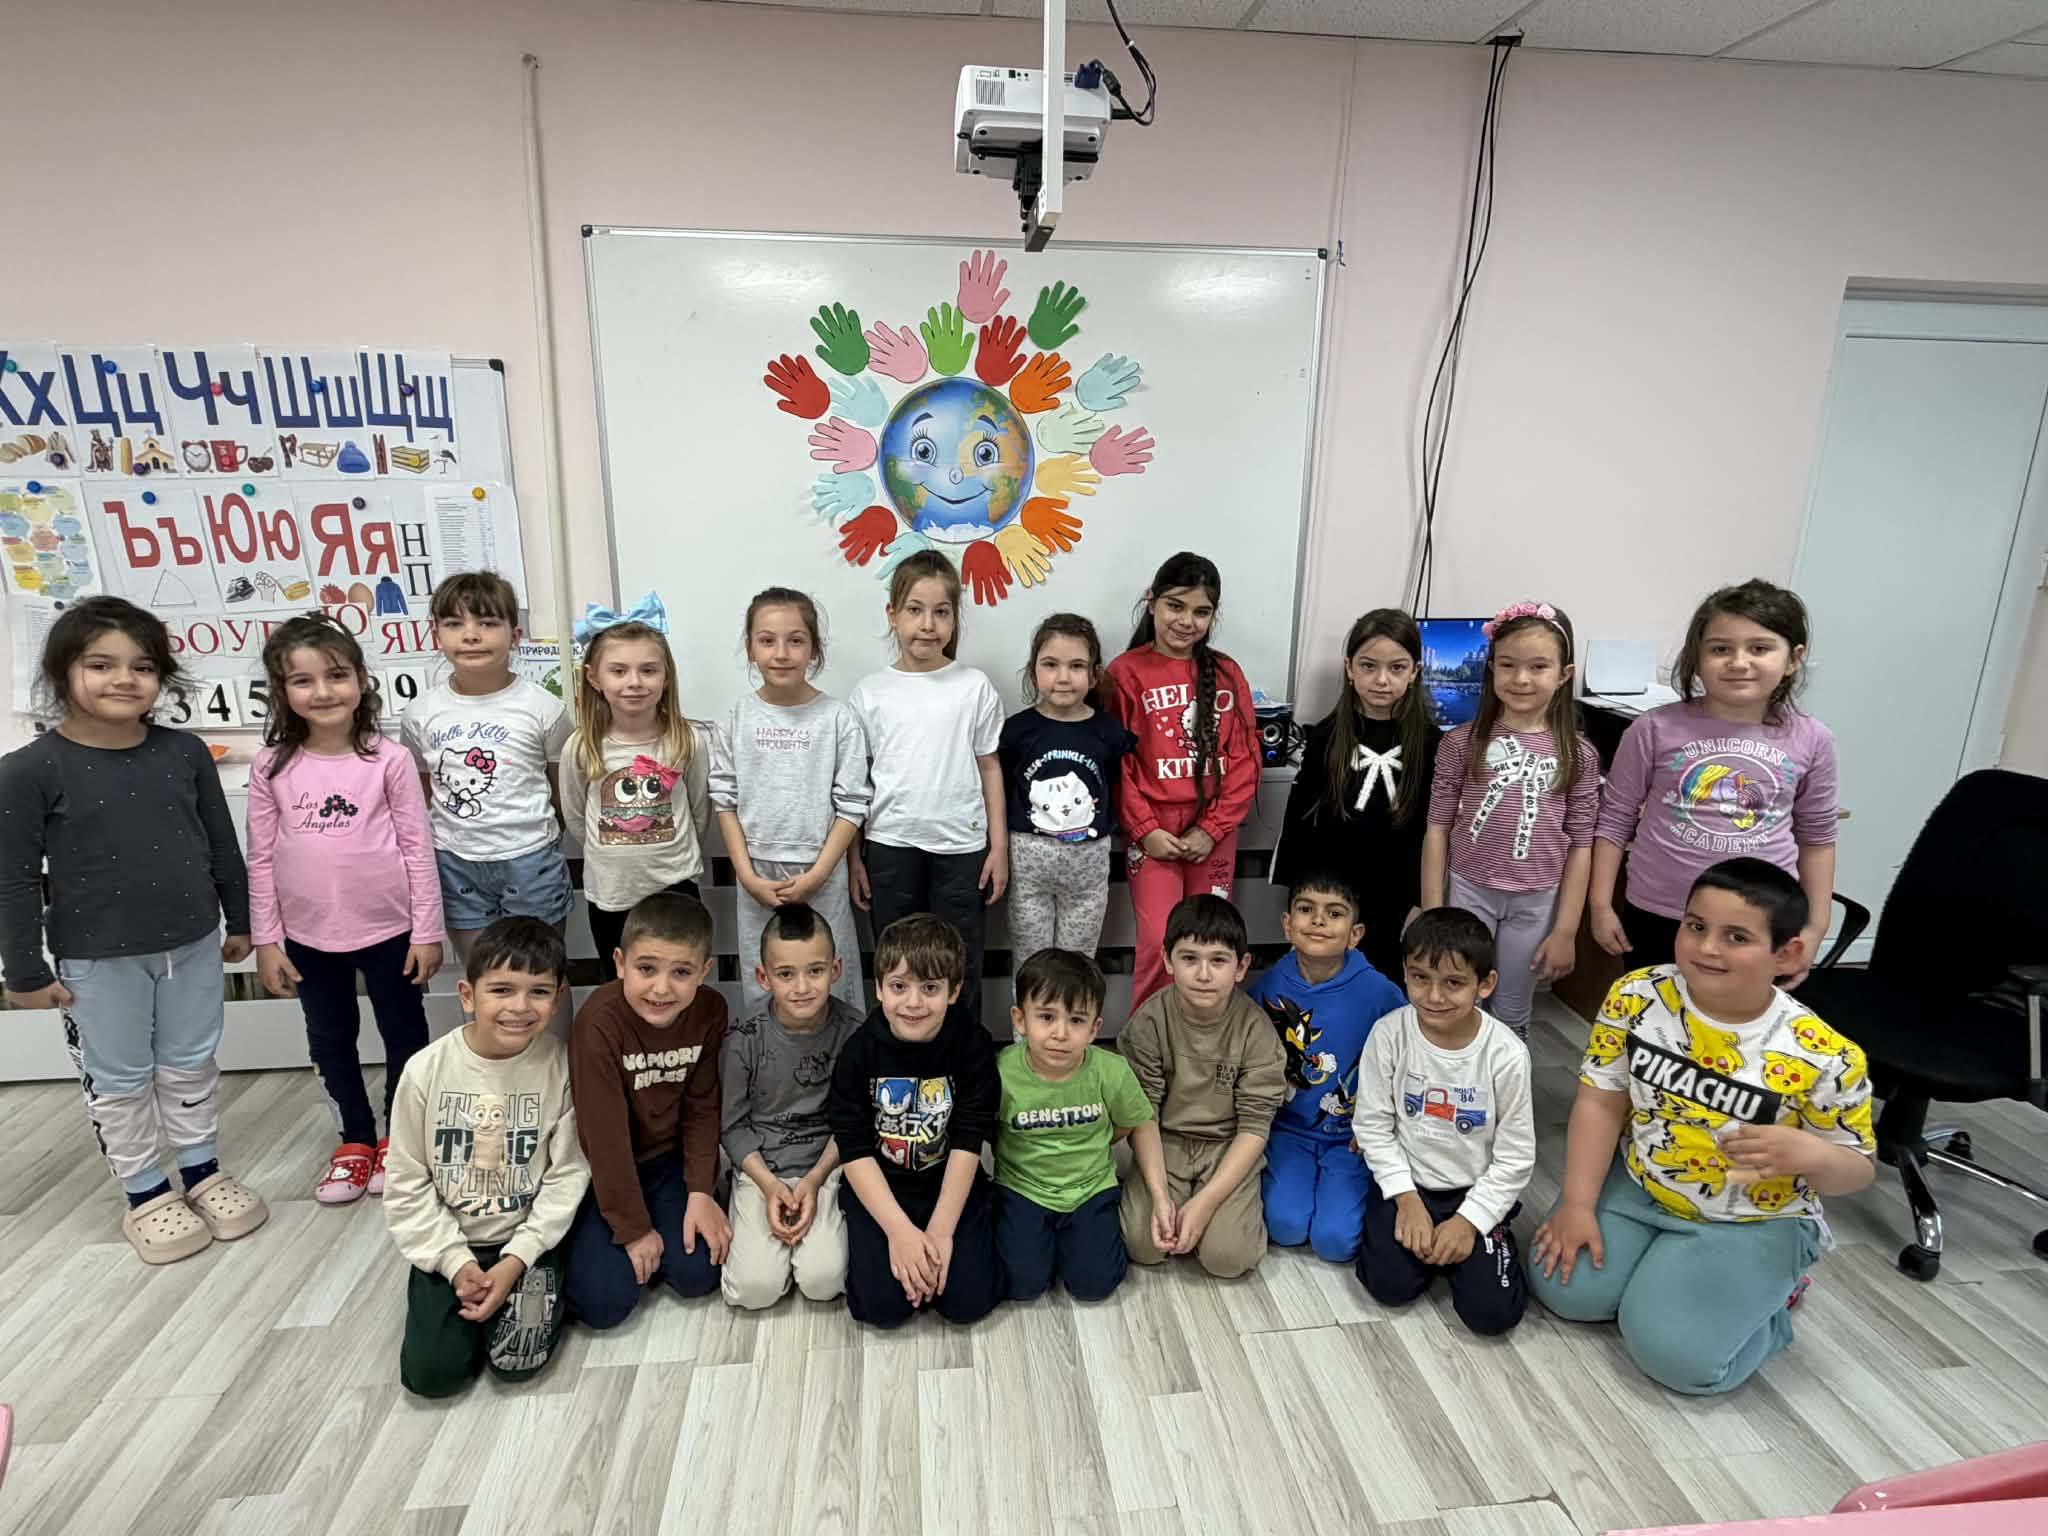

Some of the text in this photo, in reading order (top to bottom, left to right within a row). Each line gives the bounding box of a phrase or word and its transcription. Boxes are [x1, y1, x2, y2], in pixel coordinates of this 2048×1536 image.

[103, 501, 203, 568] Ъъ
[203, 493, 300, 564] Юю
[311, 503, 399, 576] Яя
[207, 683, 231, 722] 4
[1141, 684, 1234, 714] HELO
[431, 722, 510, 750] Hello Kitty
[1682, 738, 1786, 766] UNICORN
[291, 792, 318, 810] Los
[291, 811, 351, 834] Angeles
[1670, 822, 1768, 853] ACADEMY
[1631, 1046, 1763, 1121] PIKACHU
[1015, 1102, 1104, 1127] BENETTON
